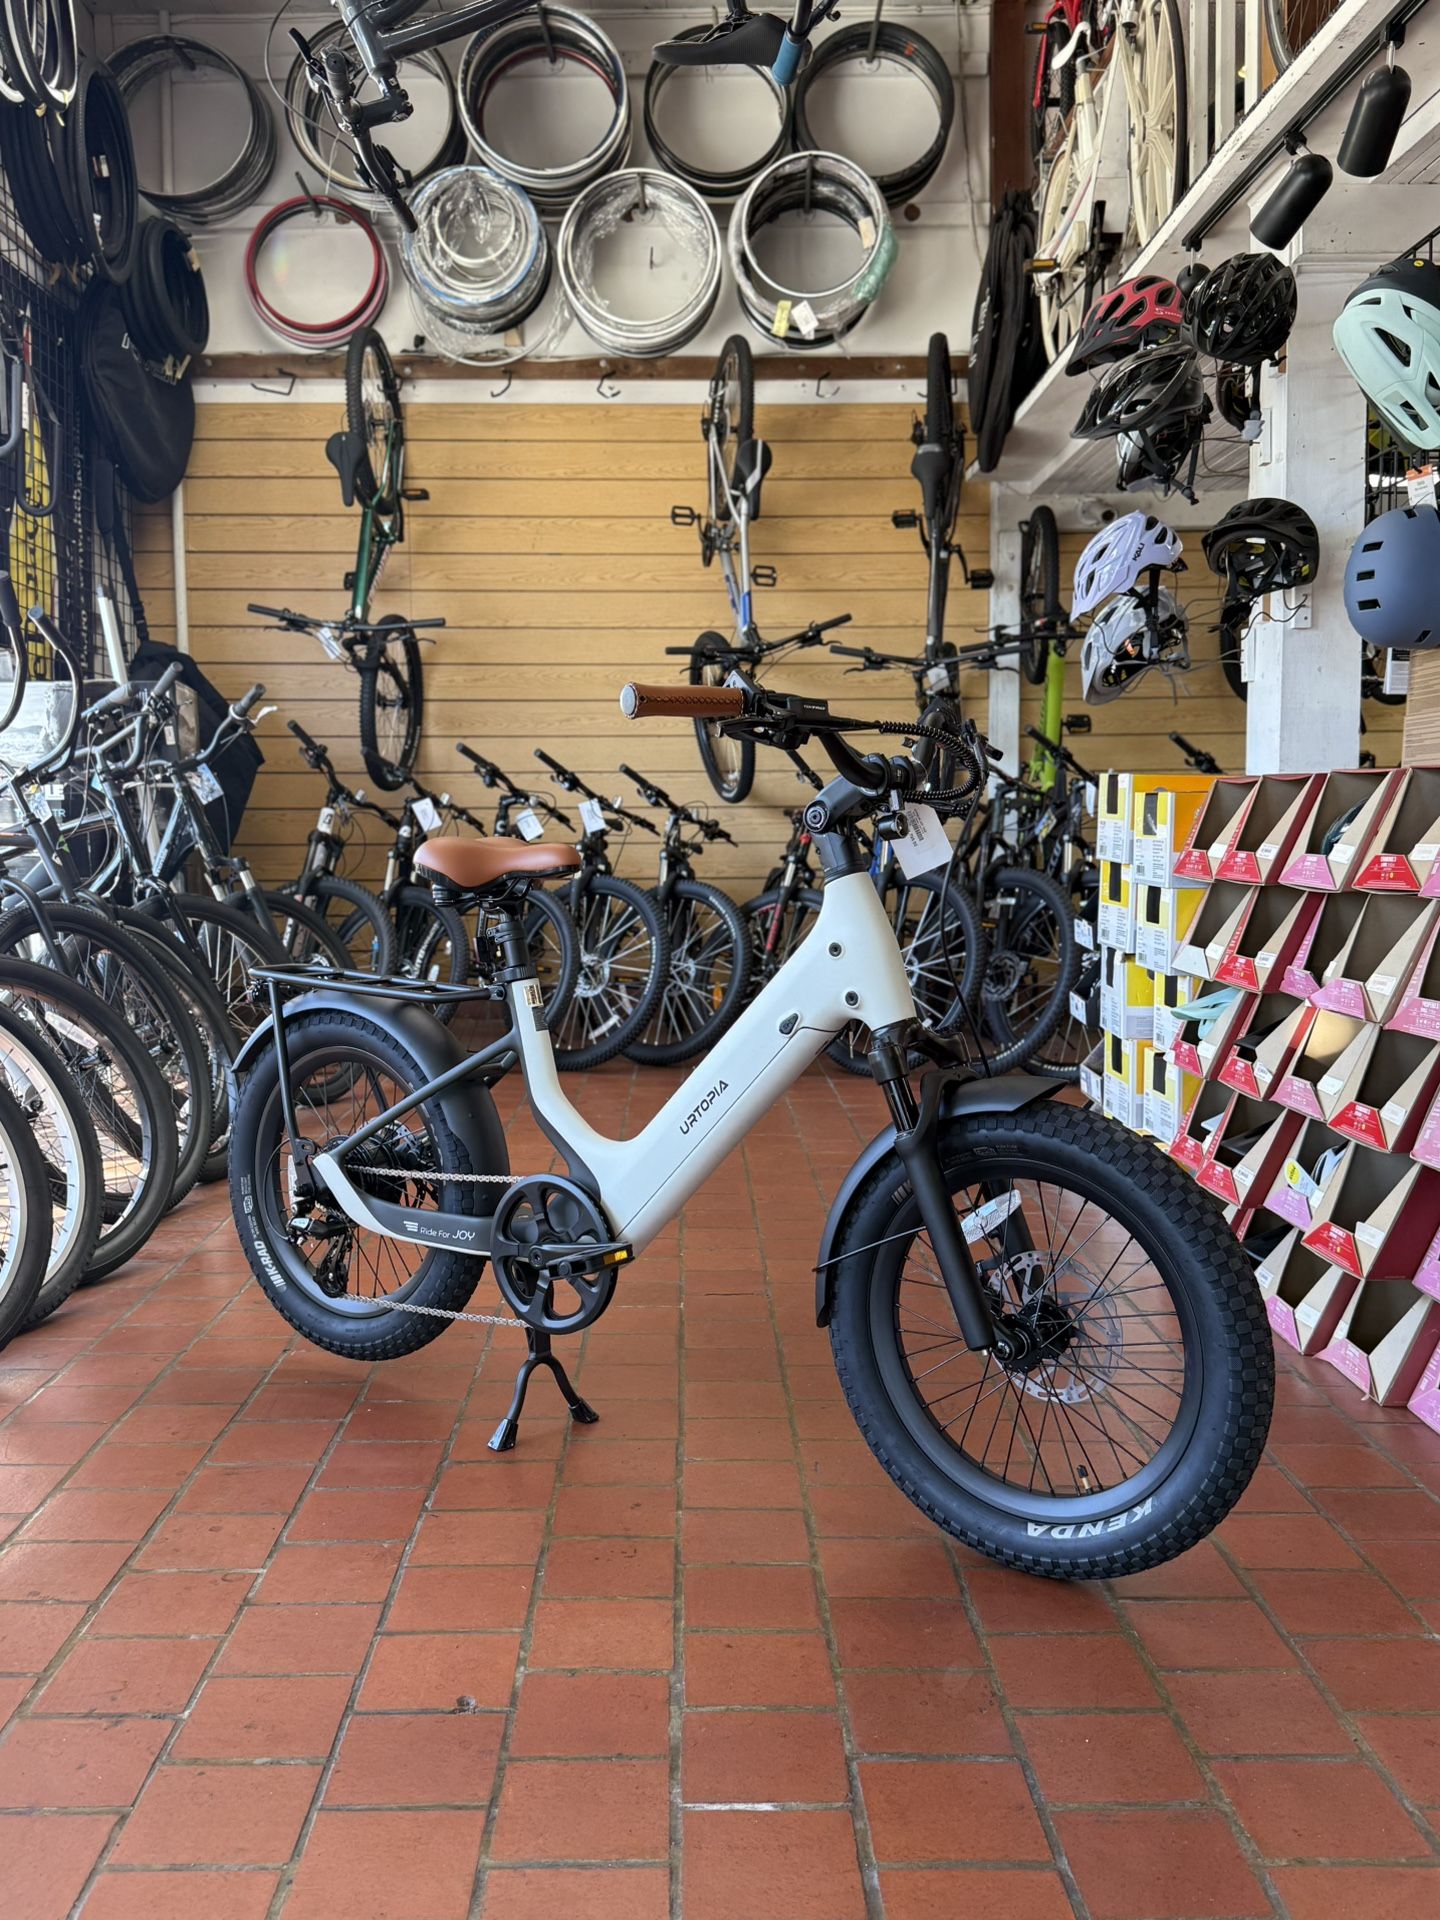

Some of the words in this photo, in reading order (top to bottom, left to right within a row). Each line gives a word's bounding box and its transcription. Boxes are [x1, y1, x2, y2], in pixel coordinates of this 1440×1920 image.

[1131, 542, 1145, 562] KALI
[680, 1079, 729, 1135] URTOPIA
[420, 1226, 437, 1237] Ride
[438, 1228, 451, 1238] For
[452, 1229, 476, 1241] JOY
[1026, 1496, 1153, 1539] KENDA
